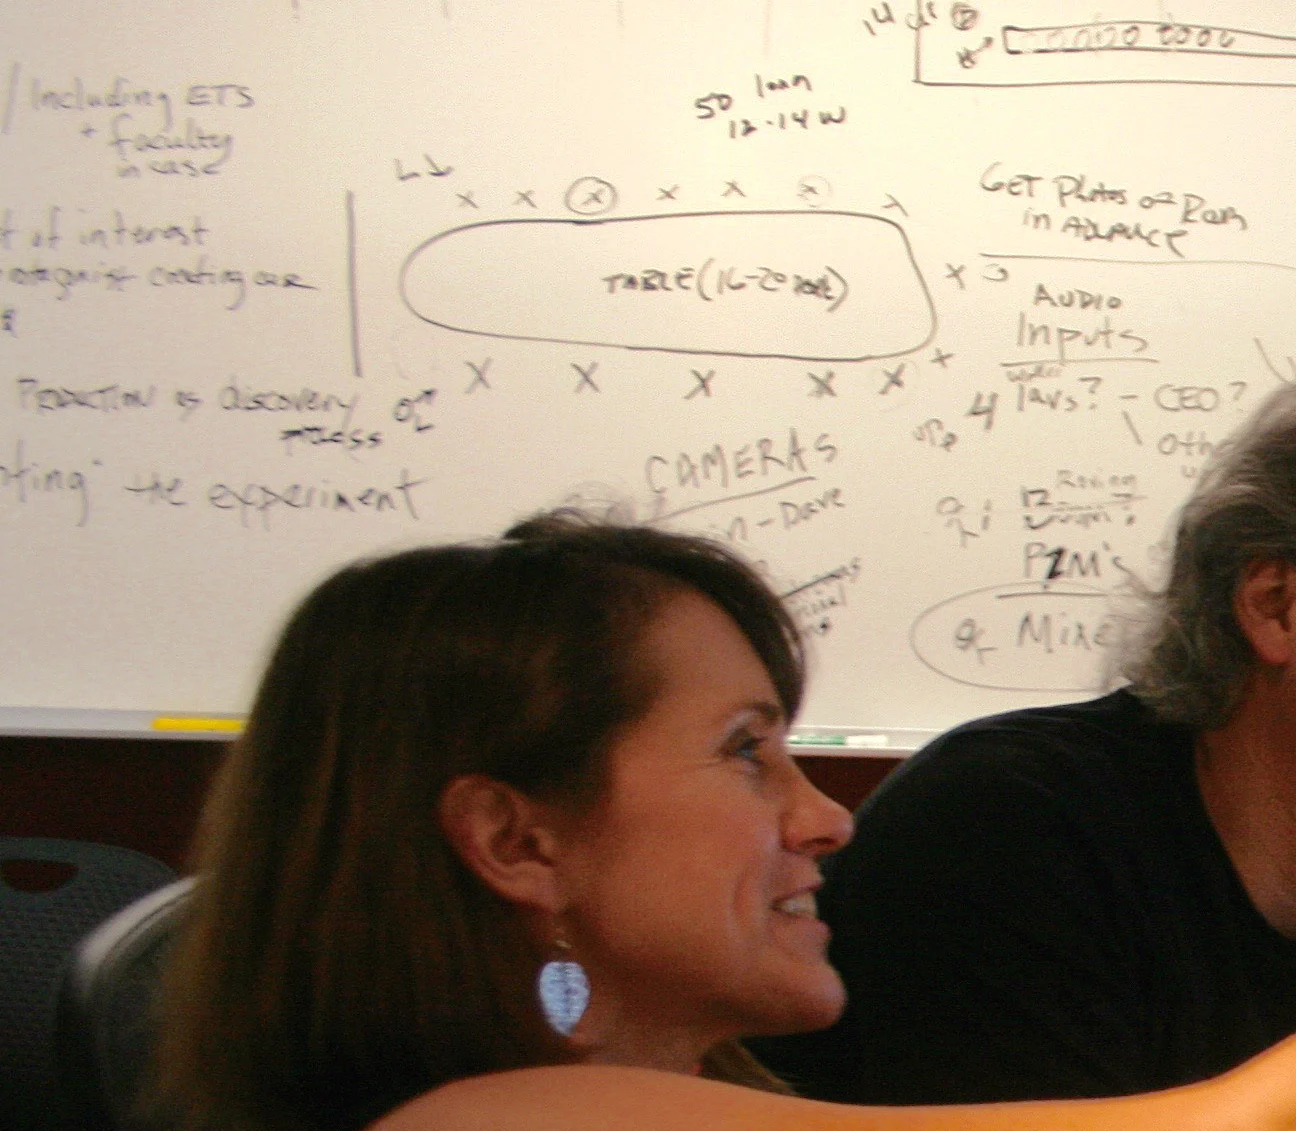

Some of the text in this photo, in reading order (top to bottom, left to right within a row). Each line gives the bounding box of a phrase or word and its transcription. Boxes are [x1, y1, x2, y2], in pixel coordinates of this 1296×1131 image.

[187, 83, 256, 108] ETS
[1032, 283, 1124, 309] AUDIO
[1015, 311, 1149, 364] Inputs
[644, 427, 839, 492] CAMERAS
